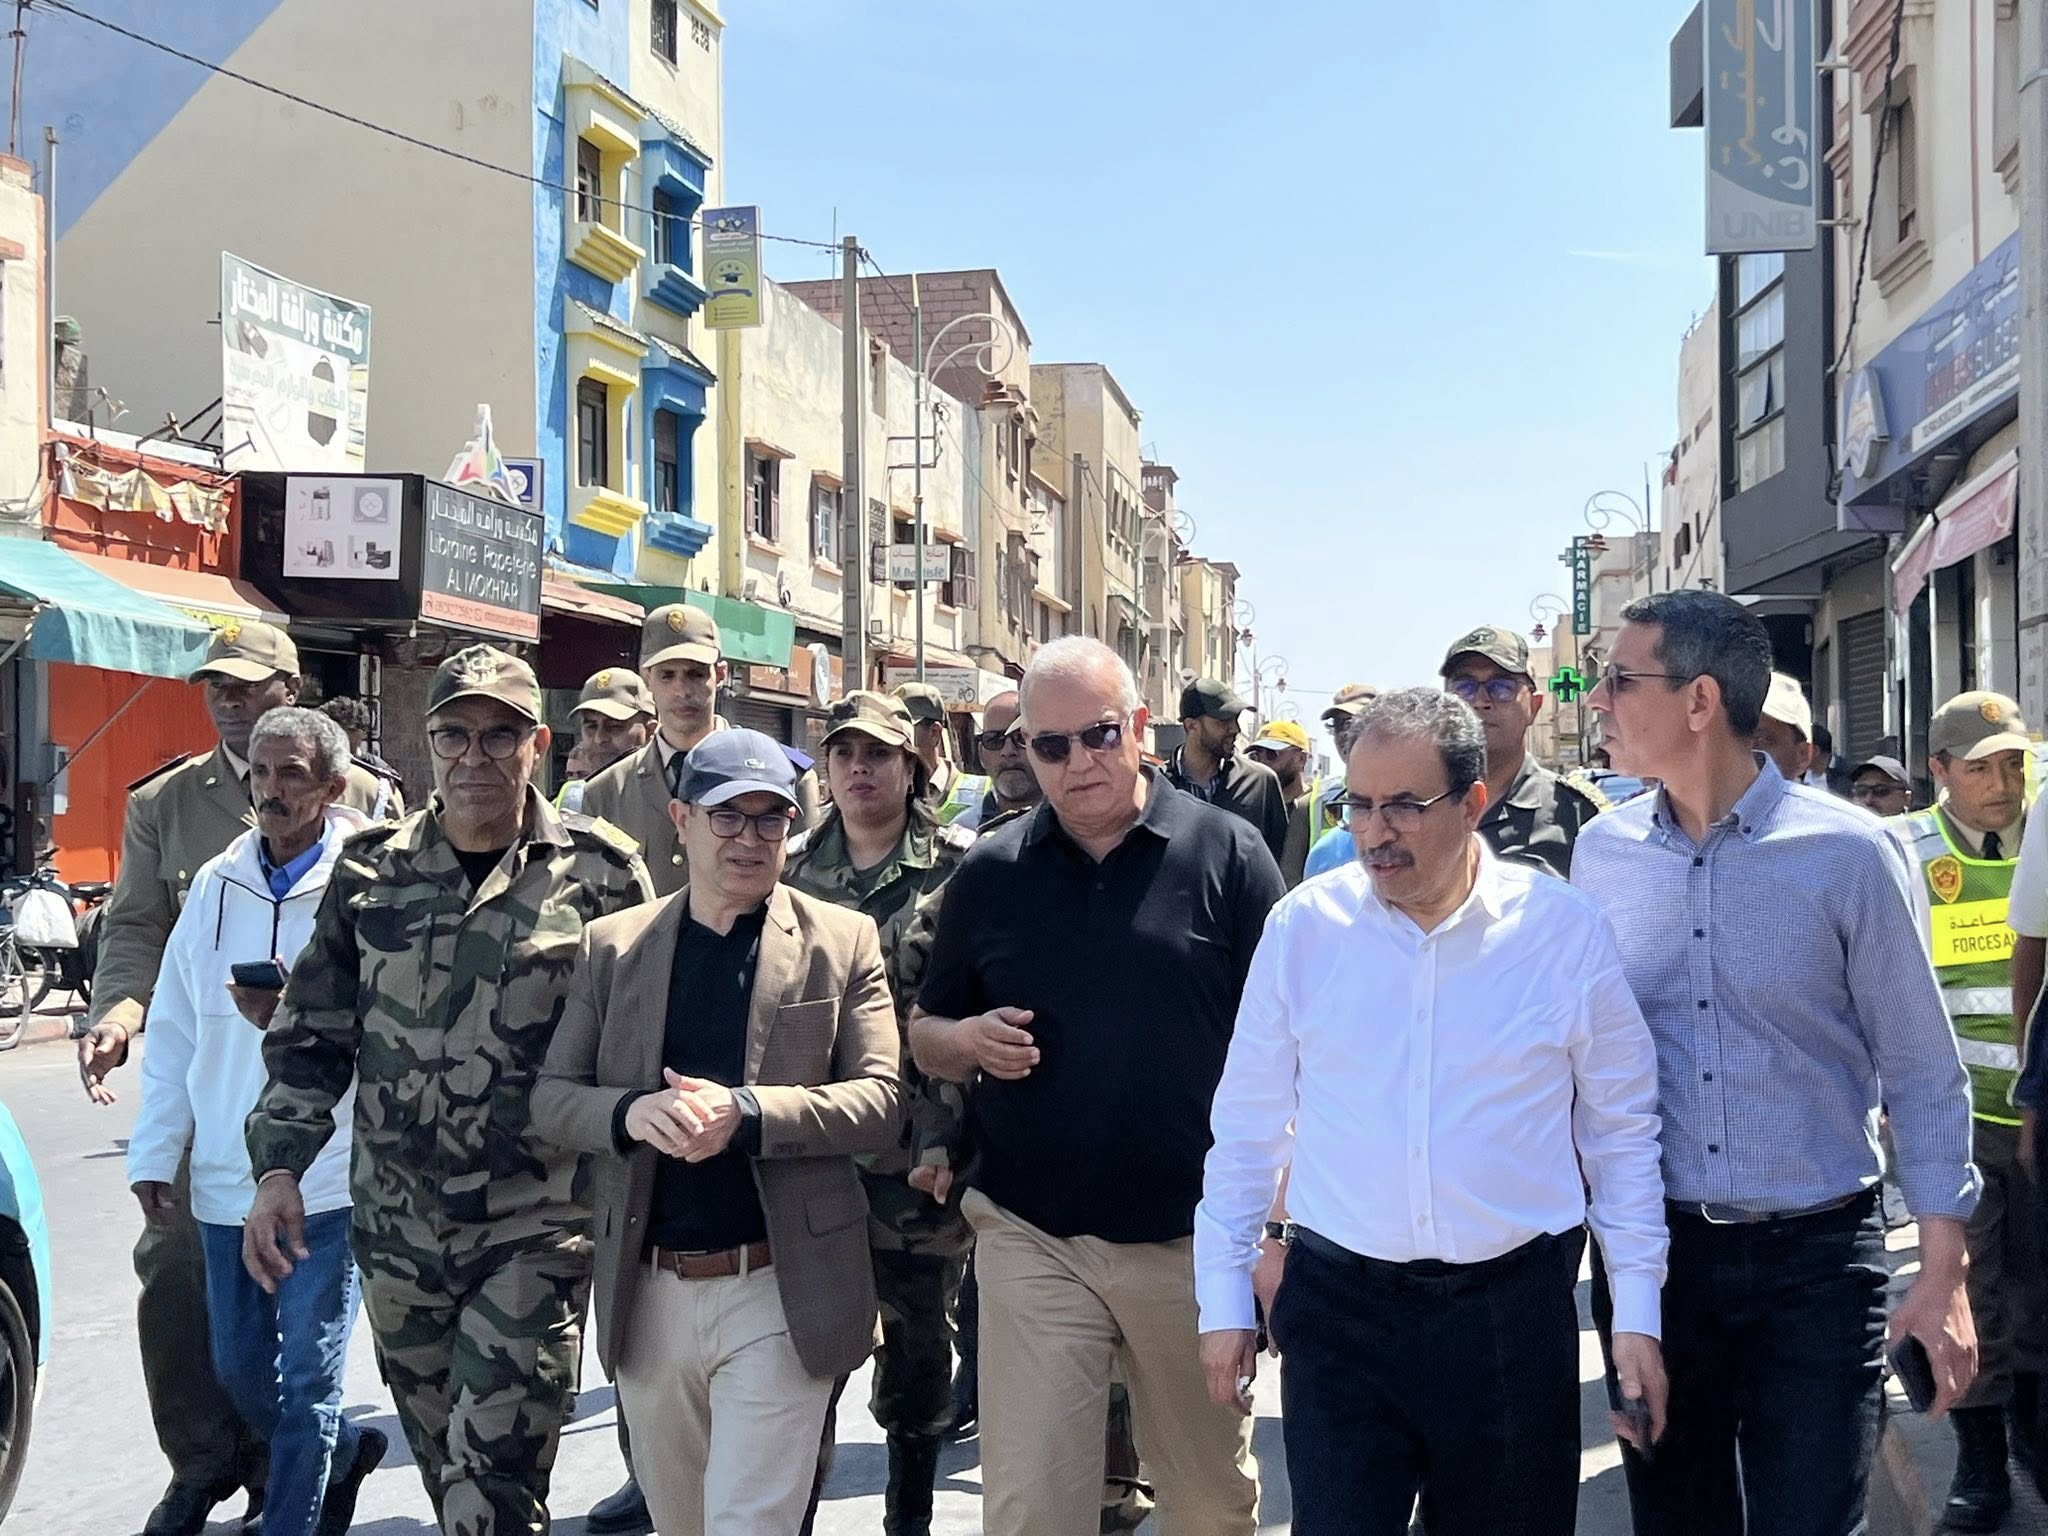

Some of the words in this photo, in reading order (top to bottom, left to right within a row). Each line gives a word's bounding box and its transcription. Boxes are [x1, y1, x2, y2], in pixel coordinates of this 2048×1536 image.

[230, 267, 278, 322] المختار
[281, 290, 320, 346] وراقة
[323, 308, 363, 355] مكتبة
[476, 506, 503, 540] وراقة
[505, 515, 538, 546] مكتبة
[446, 567, 461, 592] AL
[464, 571, 519, 603] MOKHTAR
[1575, 538, 1588, 633] PHARMACIE
[1952, 933, 2001, 954] FORCES
